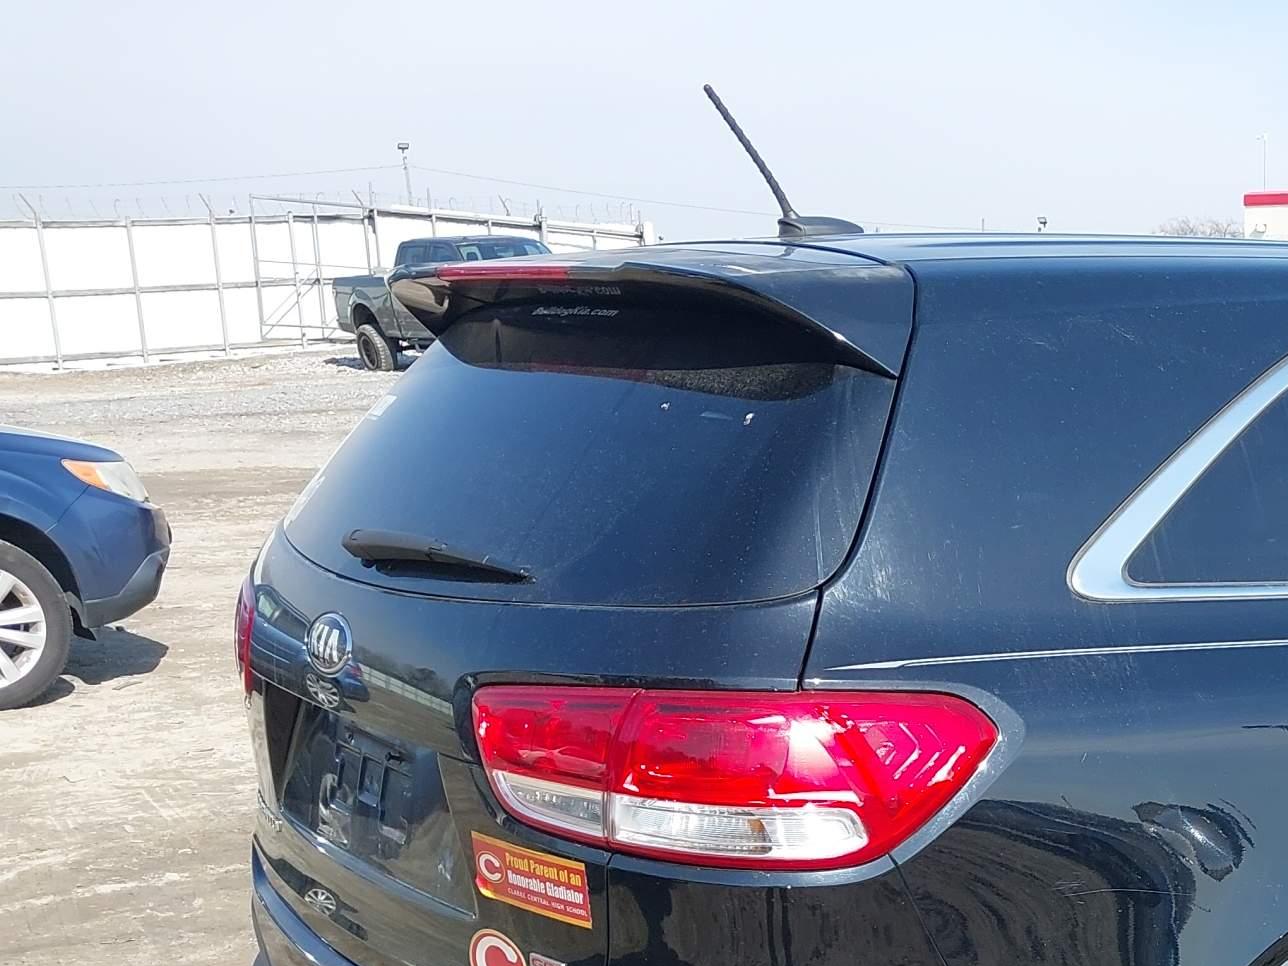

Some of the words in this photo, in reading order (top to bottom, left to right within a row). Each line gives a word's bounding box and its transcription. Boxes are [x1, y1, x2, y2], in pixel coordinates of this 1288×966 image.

[310, 622, 340, 663] KIA
[505, 853, 529, 873] Proud
[529, 860, 558, 880] Parent
[559, 869, 568, 885] of
[570, 872, 582, 887] an
[507, 870, 546, 894] Honorable
[546, 881, 584, 905] Gladiator
[527, 893, 550, 906] CENTRAL
[551, 901, 565, 911] HIGH
[566, 905, 588, 917] SCHOOL
